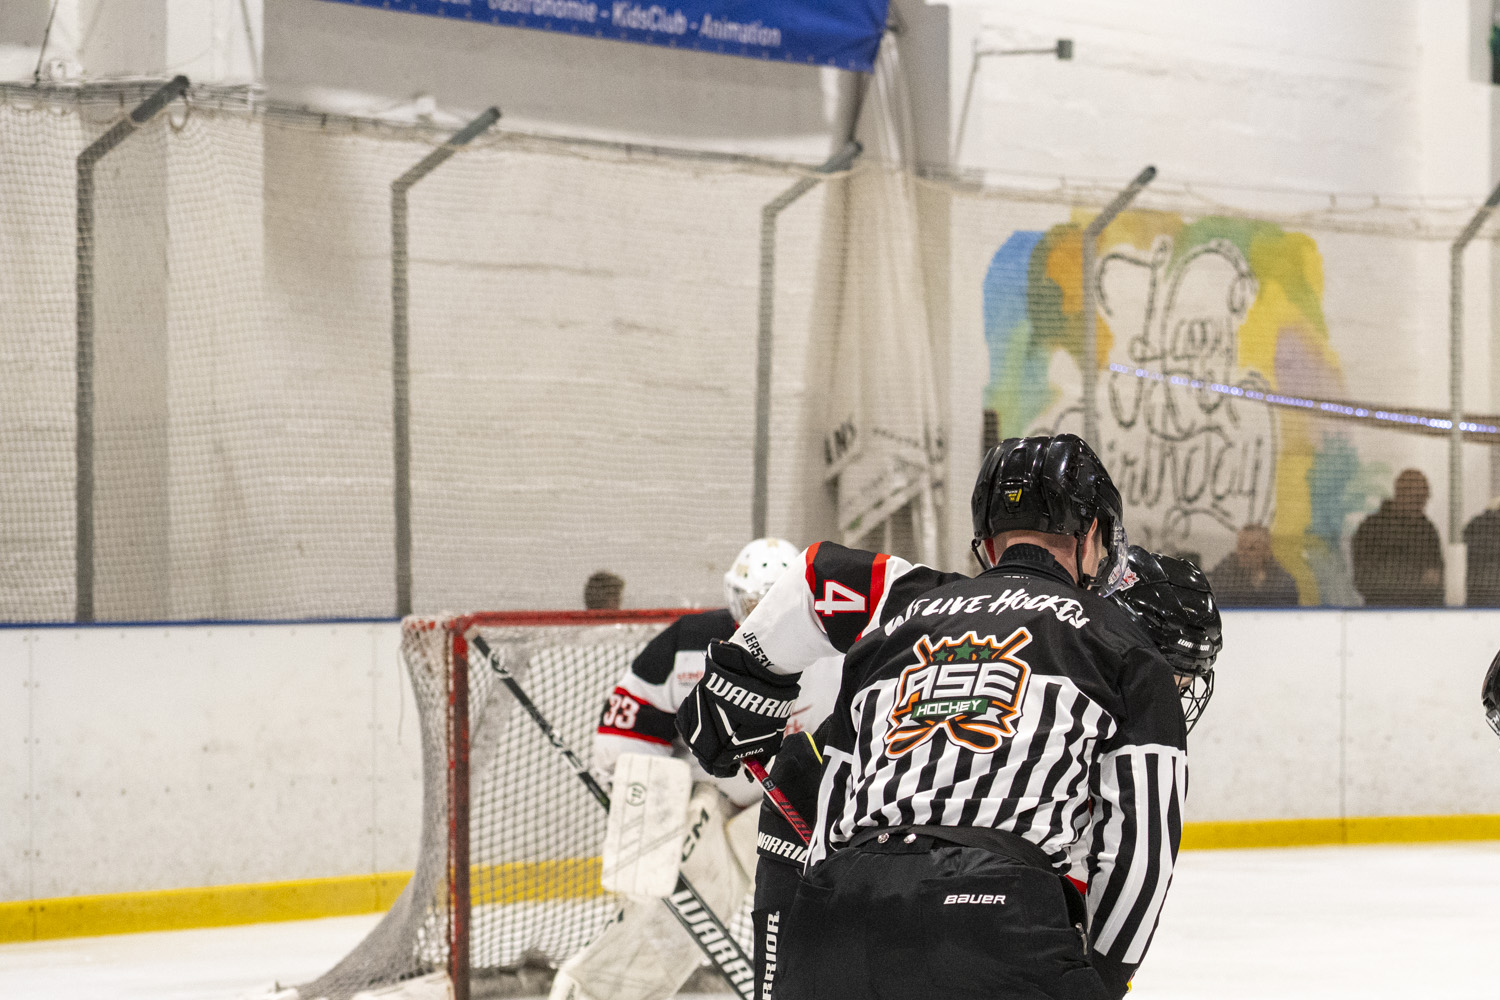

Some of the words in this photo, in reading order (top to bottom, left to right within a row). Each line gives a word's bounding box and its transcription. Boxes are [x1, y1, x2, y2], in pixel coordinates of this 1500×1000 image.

[611, 4, 687, 36] KidsClub
[699, 14, 781, 47] Animation
[814, 580, 868, 616] 4
[921, 594, 993, 616] LIVE
[988, 588, 1090, 629] HOCKEY
[705, 672, 796, 719] WARRIO
[902, 662, 1021, 699] ASE
[603, 693, 641, 730] 33
[916, 699, 983, 718] HOCKEY
[758, 832, 808, 865] WARRIO
[943, 893, 1006, 906] BAUER
